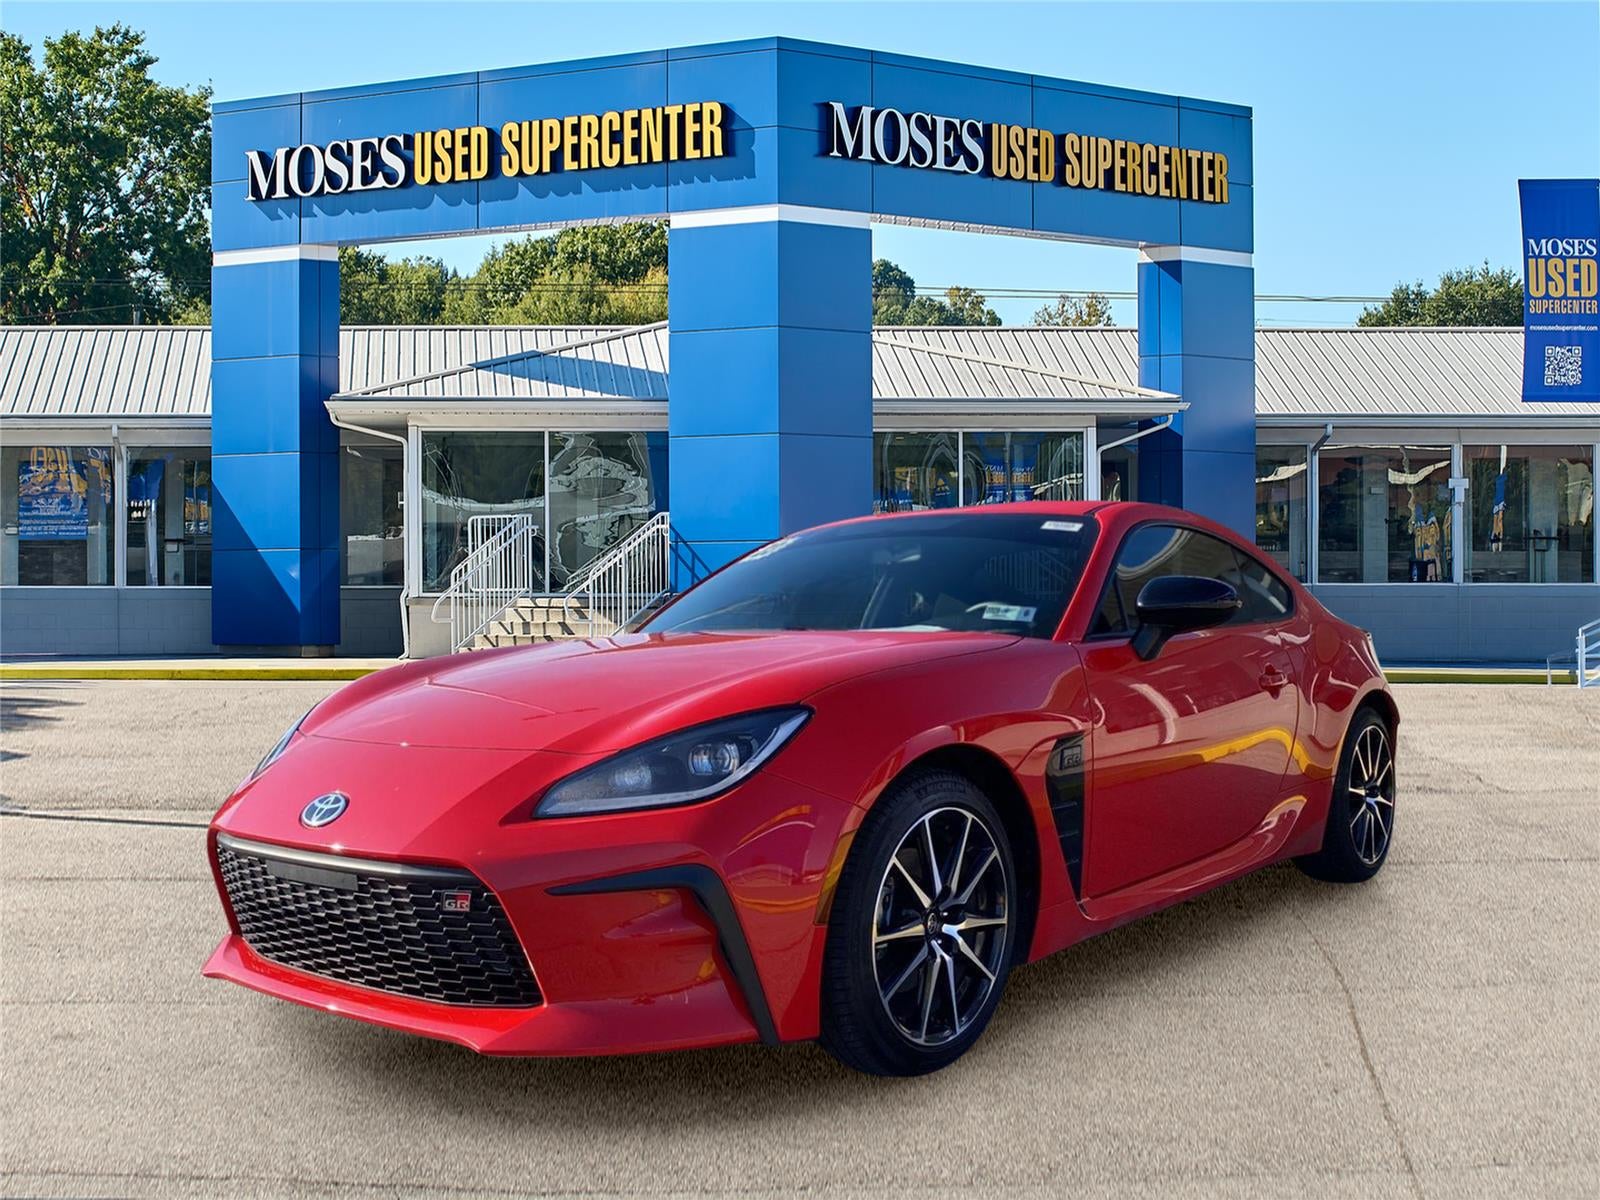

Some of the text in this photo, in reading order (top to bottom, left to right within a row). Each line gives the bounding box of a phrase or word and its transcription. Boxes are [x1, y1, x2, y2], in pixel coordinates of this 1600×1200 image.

[245, 101, 724, 201] MOSES USED SUPERCENTER
[829, 101, 1229, 203] MOSES USED SUPERCENTER
[1527, 238, 1597, 257] MOSES
[1528, 258, 1598, 298] USED
[1529, 299, 1598, 314] SUPERCENTER
[445, 899, 470, 910] GR
